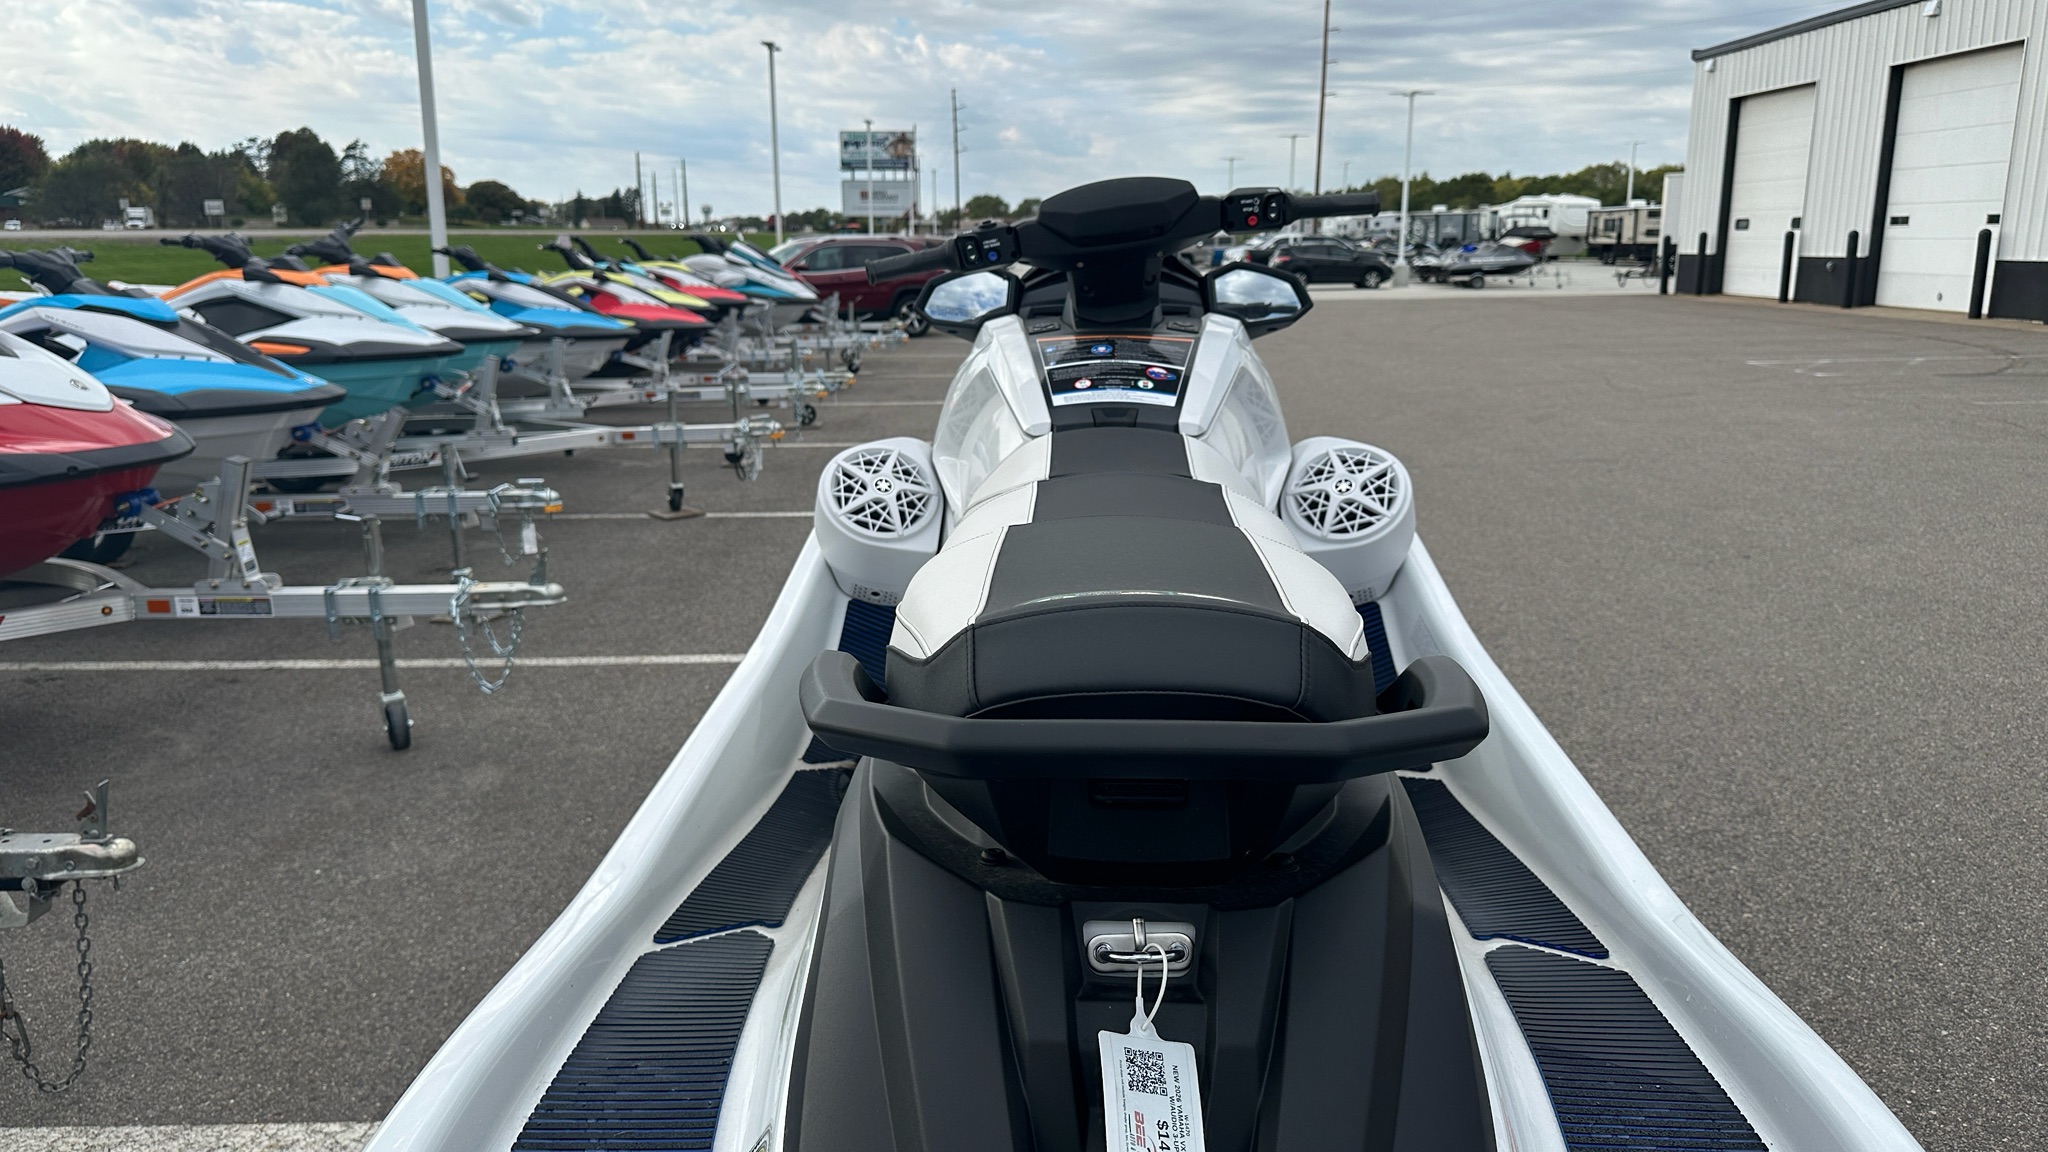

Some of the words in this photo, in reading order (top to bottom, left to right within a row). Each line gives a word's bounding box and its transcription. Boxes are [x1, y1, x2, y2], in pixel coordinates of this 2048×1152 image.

[1169, 1096, 1178, 1131] W/AUDIO
[1172, 1064, 1180, 1083] NEW
[1176, 1104, 1185, 1138] YAMAHA
[1134, 1111, 1146, 1148] BEE
